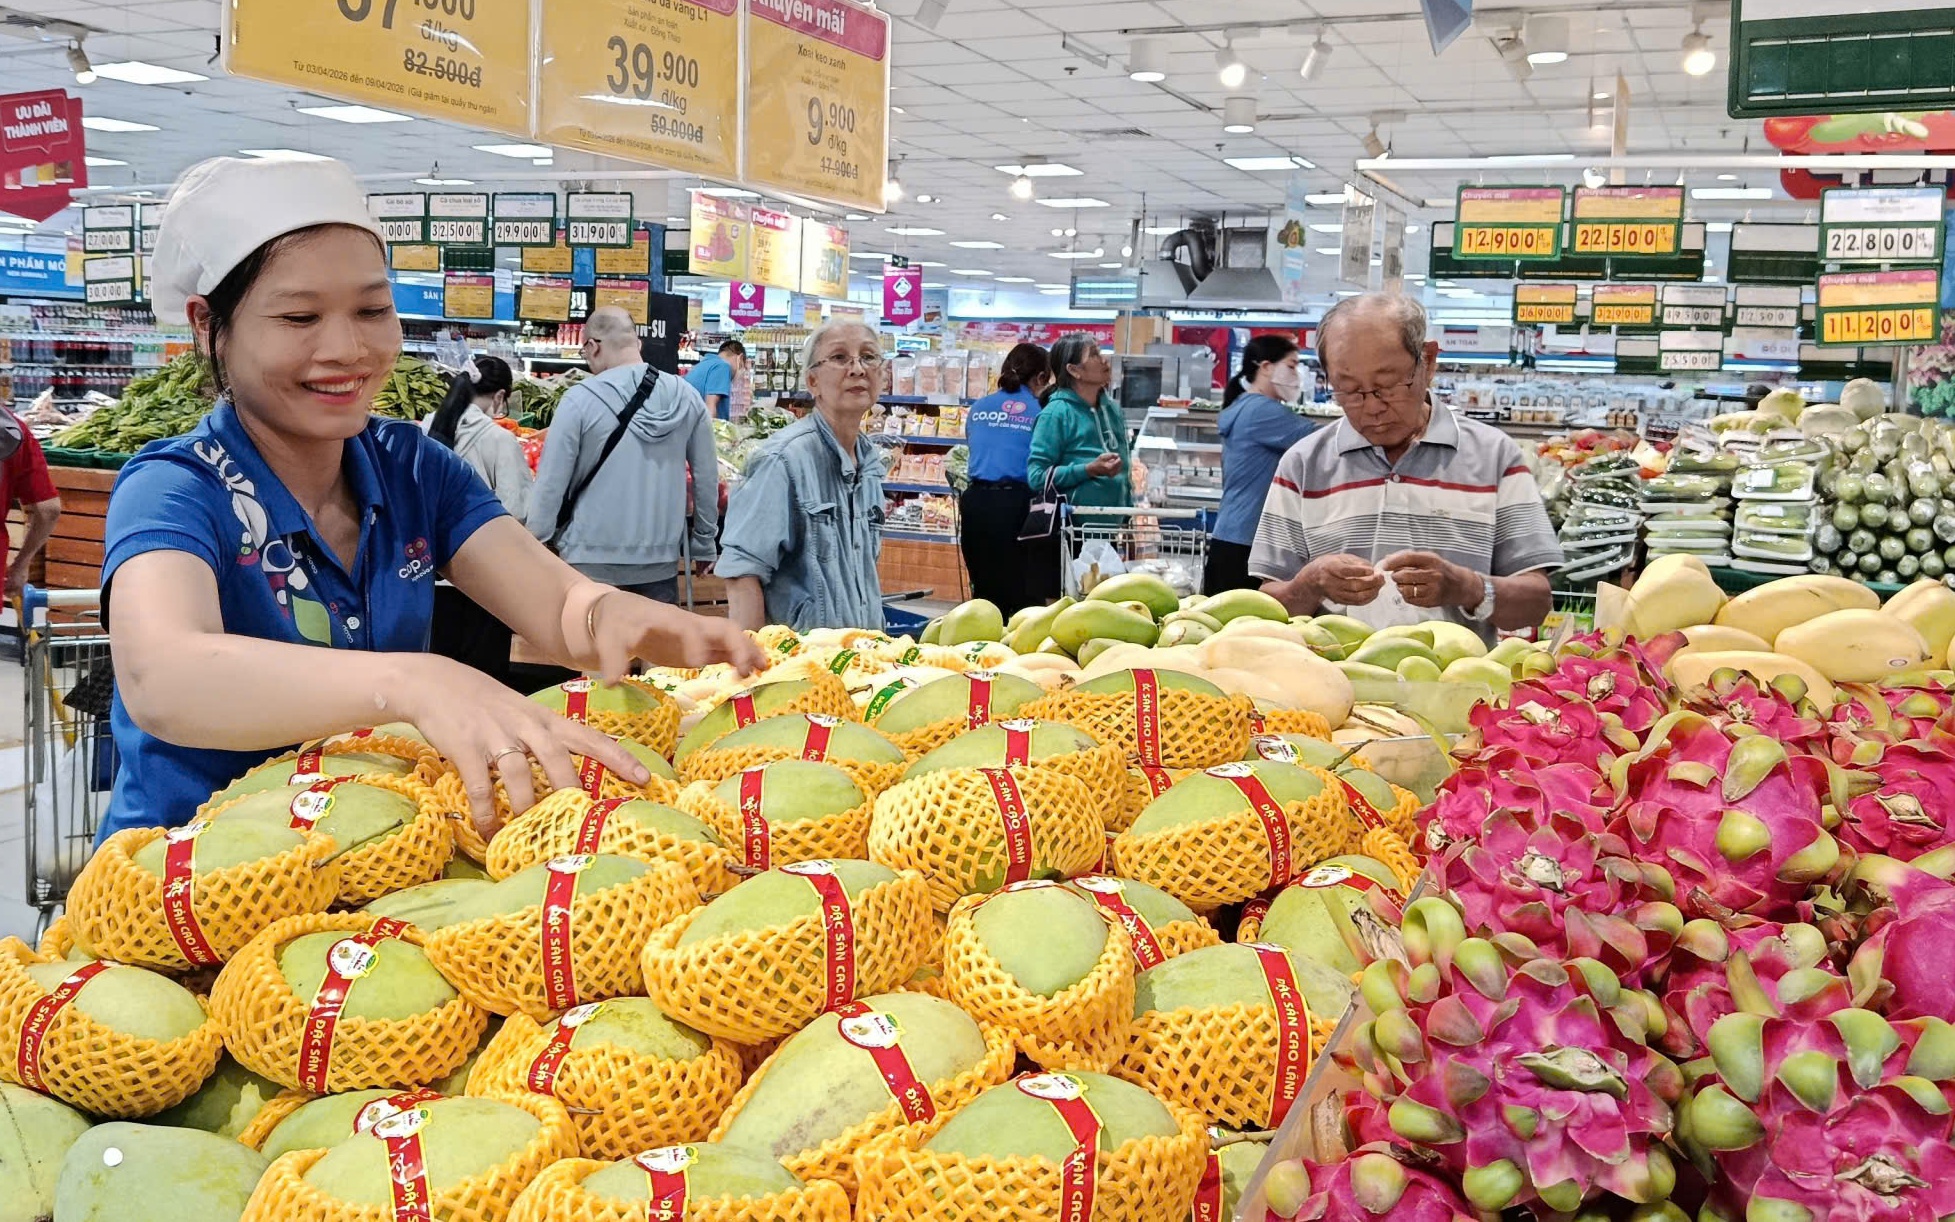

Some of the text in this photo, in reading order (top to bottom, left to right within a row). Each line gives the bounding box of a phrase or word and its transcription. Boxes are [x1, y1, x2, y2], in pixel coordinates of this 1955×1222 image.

[698, 7, 708, 21] L1
[816, 8, 845, 36] mãi
[421, 18, 458, 52] đ/kg
[306, 64, 348, 81] 03/04/2026
[365, 77, 405, 94] 09/04/2026
[403, 48, 482, 88] 82.500đ
[33, 101, 51, 117] ĐÃI
[661, 89, 687, 115] đ/kg
[4, 118, 68, 139] THÀNH VIÊN
[650, 113, 704, 144] 59.000đ
[827, 136, 847, 156] đ/kg
[497, 225, 539, 238] 29.900
[572, 225, 615, 239] 31.900
[1468, 231, 1534, 248] 12.900
[1580, 228, 1654, 246] 22.500
[1832, 233, 1913, 251] 22.800
[10, 257, 66, 272] PHẨM MỚ
[1829, 313, 1910, 334] 11.200
[1142, 693, 1152, 712] SẢN
[1143, 715, 1152, 737] CAO
[998, 783, 1013, 803] SẢN
[1006, 805, 1020, 829] CAO
[1013, 829, 1026, 864] LÃNH
[1260, 803, 1279, 826] ĐẶC
[752, 838, 762, 858] CAO
[1272, 826, 1284, 850] SẢN
[1275, 851, 1285, 875] CAO
[171, 900, 186, 925] SẢN
[180, 925, 198, 947] CAO
[549, 938, 562, 965] SẢN
[829, 904, 847, 995] ĐẶC SẢN CAO
[1137, 937, 1157, 963] SẢN
[552, 968, 565, 991] CAO
[48, 987, 72, 1005] ĐẶC
[29, 1001, 50, 1034] SẢN
[308, 1019, 327, 1047] ĐẶC
[1275, 977, 1300, 1100] ĐẶC SẢN CAO LÃNH
[25, 1035, 35, 1063] CAO
[308, 1048, 322, 1073] SẢN
[533, 1041, 565, 1089] ĐẶC SẢN
[905, 1087, 925, 1118] ĐẶC
[403, 1181, 419, 1211] ĐẶC
[1071, 1151, 1087, 1222] SẢN CAO
[659, 1199, 676, 1222] ĐẶ
